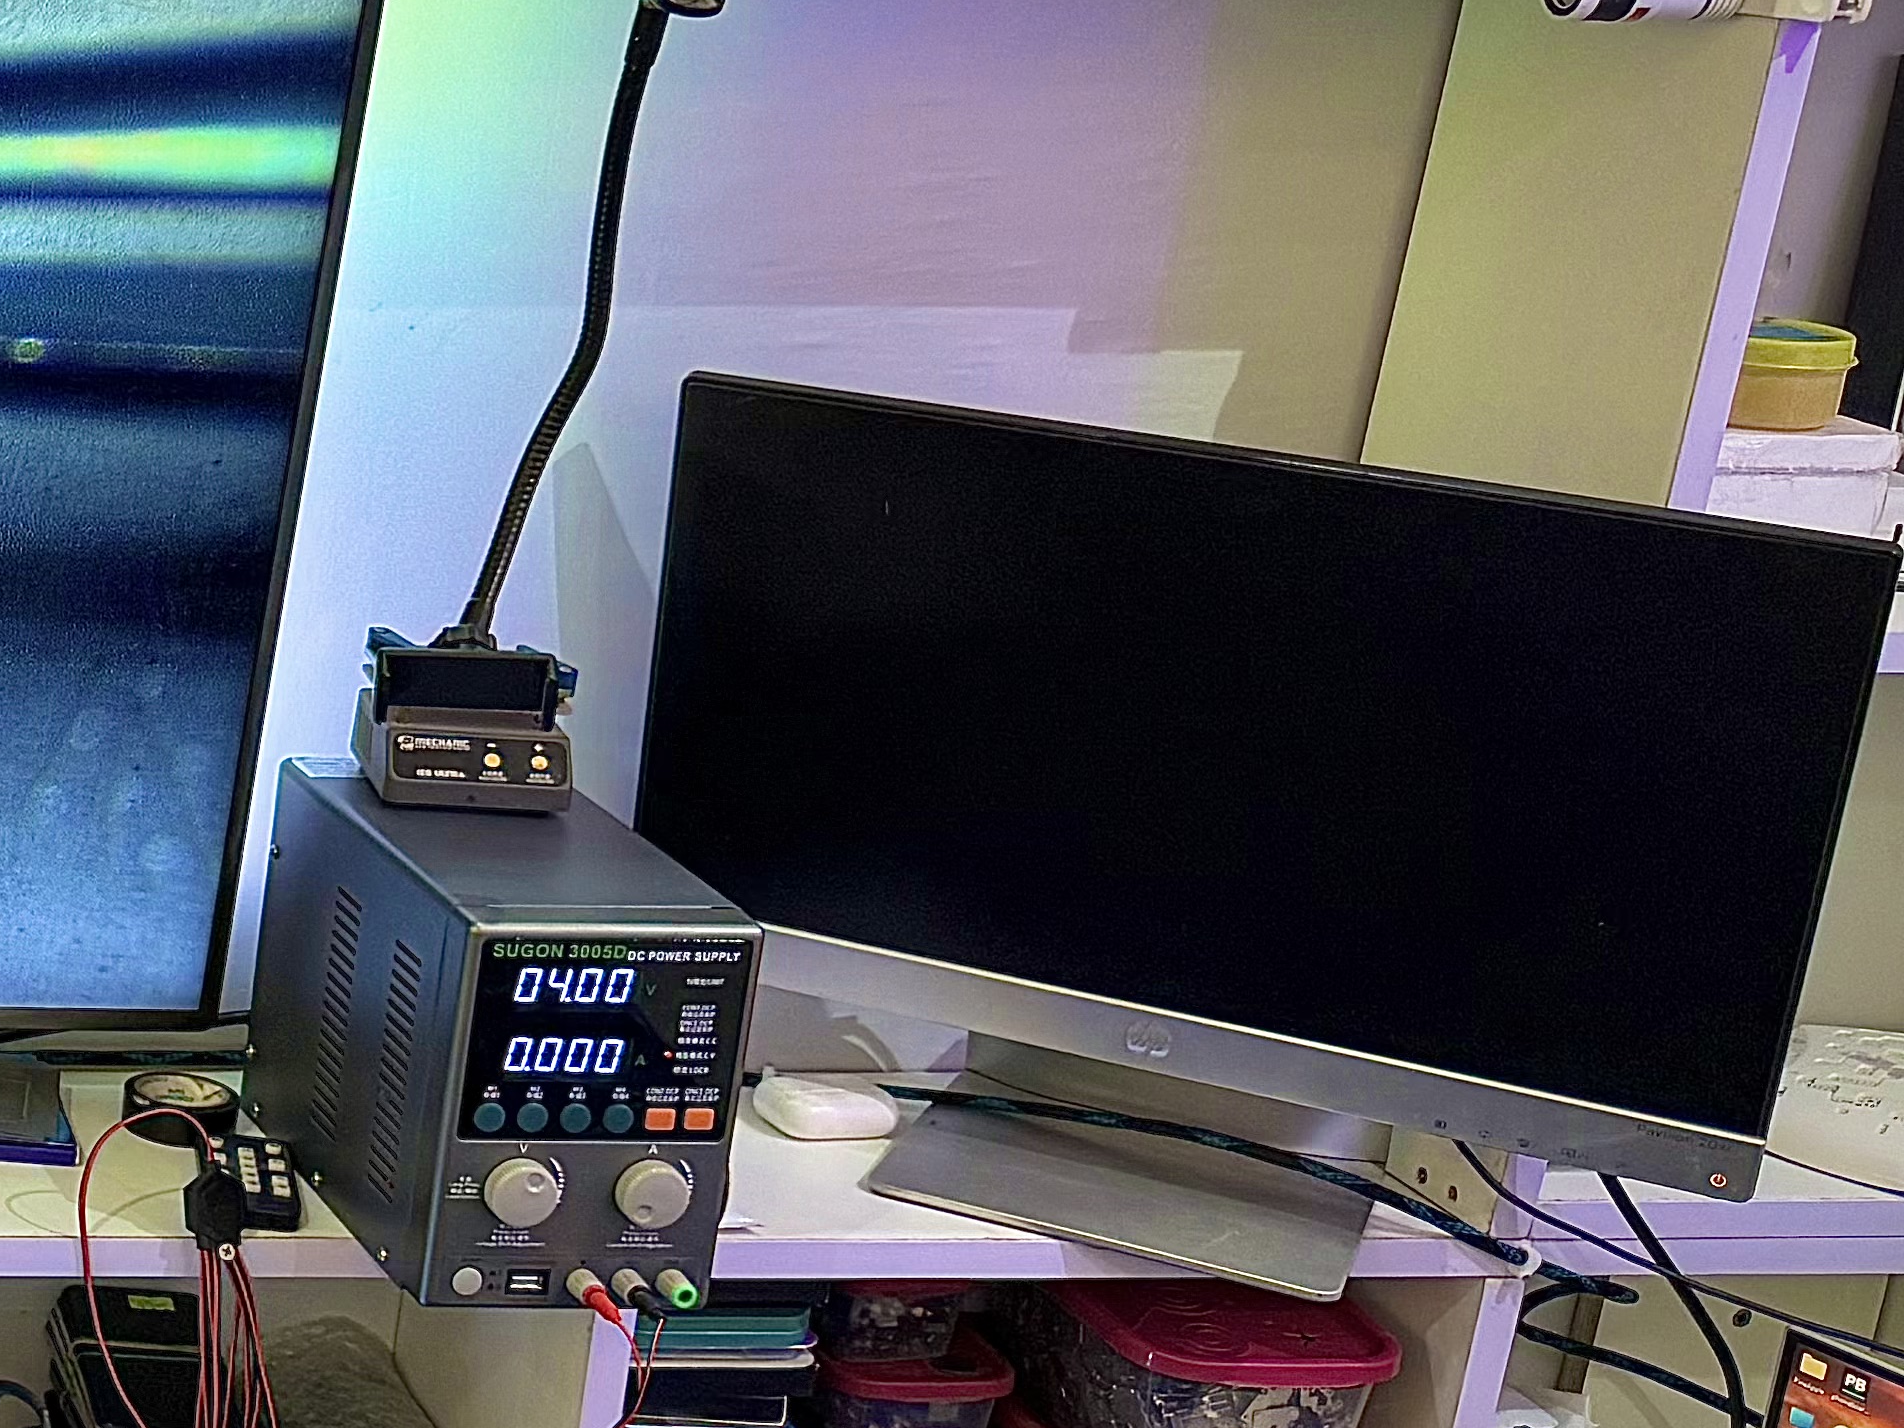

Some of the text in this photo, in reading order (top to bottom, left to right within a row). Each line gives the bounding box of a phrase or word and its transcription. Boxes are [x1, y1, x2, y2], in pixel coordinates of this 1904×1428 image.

[493, 944, 626, 958] SUGON 3005D
[627, 951, 741, 962] DC POWER SUPPLY
[513, 968, 636, 1004] 04.00
[645, 985, 657, 996] V
[503, 1037, 625, 1073] 0.000
[634, 1055, 646, 1066] A
[518, 1143, 529, 1153] V
[648, 1144, 658, 1154] A
[1844, 1373, 1867, 1392] PB
